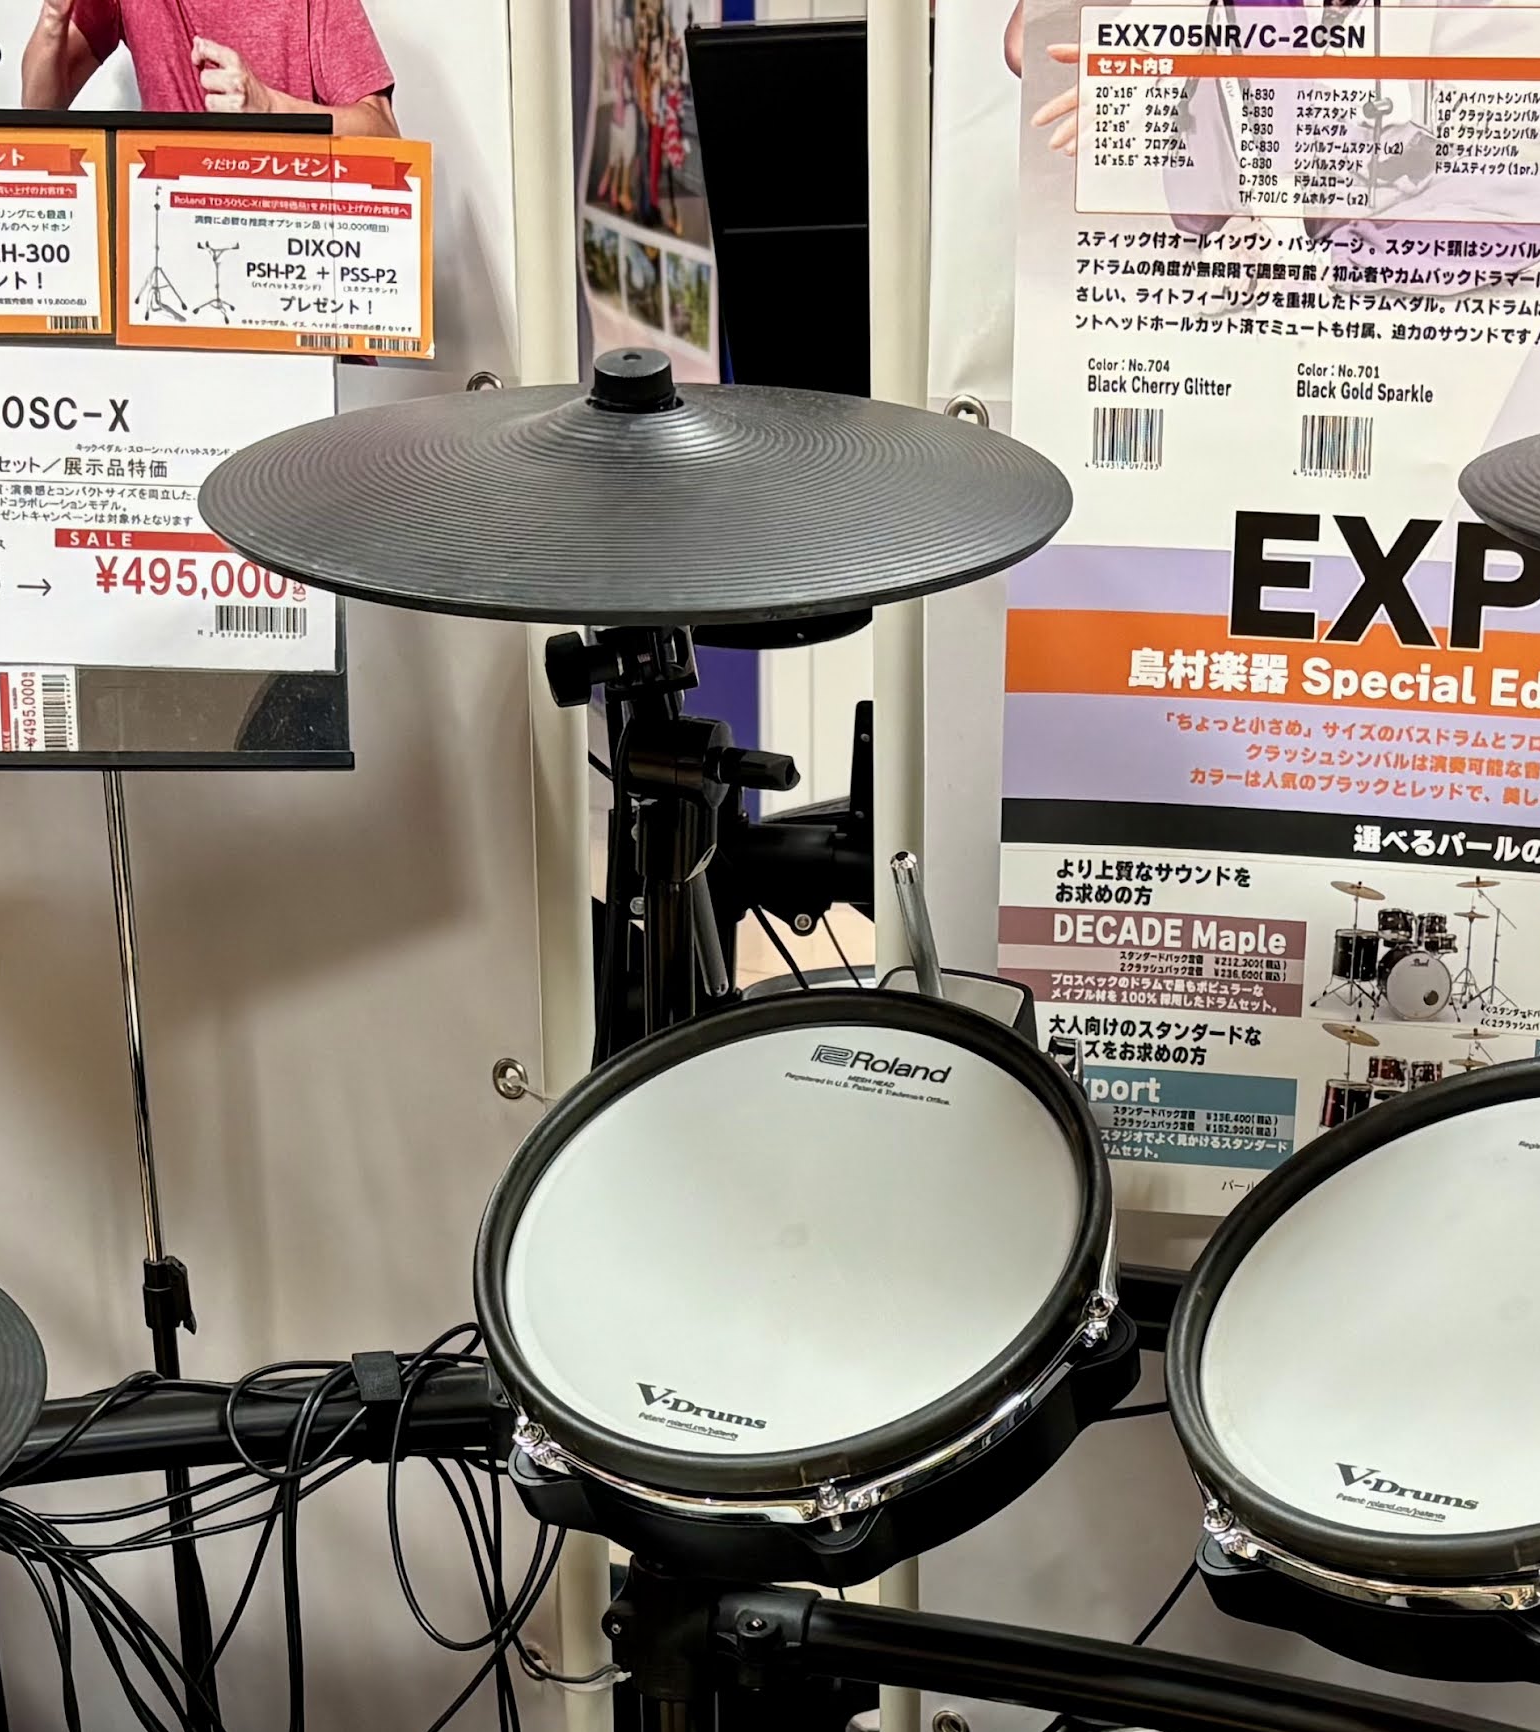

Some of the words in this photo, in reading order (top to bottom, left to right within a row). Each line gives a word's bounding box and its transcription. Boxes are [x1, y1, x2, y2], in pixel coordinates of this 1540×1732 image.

[1097, 24, 1366, 49] EXX705NR/C-2CSN
[1097, 57, 1174, 76] セット内容
[201, 156, 348, 179] 今だけのプレゼント
[287, 238, 361, 258] DIXON
[246, 262, 307, 280] PSH-P2
[340, 266, 398, 284] PSS-P2
[280, 296, 373, 315] プレゼント！
[1087, 375, 1127, 394] Black
[1131, 376, 1180, 398] Cherry
[1184, 377, 1232, 398] Glitter
[1297, 380, 1337, 399] Black
[1340, 381, 1374, 401] Gold
[1377, 383, 1434, 404] Sparkle
[70, 531, 133, 548] SALE
[1128, 646, 1289, 696] 島村楽器
[1302, 658, 1477, 706] Special
[1055, 858, 1252, 888] より上質なサウンドを
[1055, 883, 1153, 906] お求めの方
[1053, 912, 1184, 949] DECADE
[1191, 921, 1287, 955] Maple
[1049, 1014, 1262, 1046] 大人向けのスタンダードな
[850, 1050, 952, 1084] Roland
[1082, 1076, 1162, 1104] port
